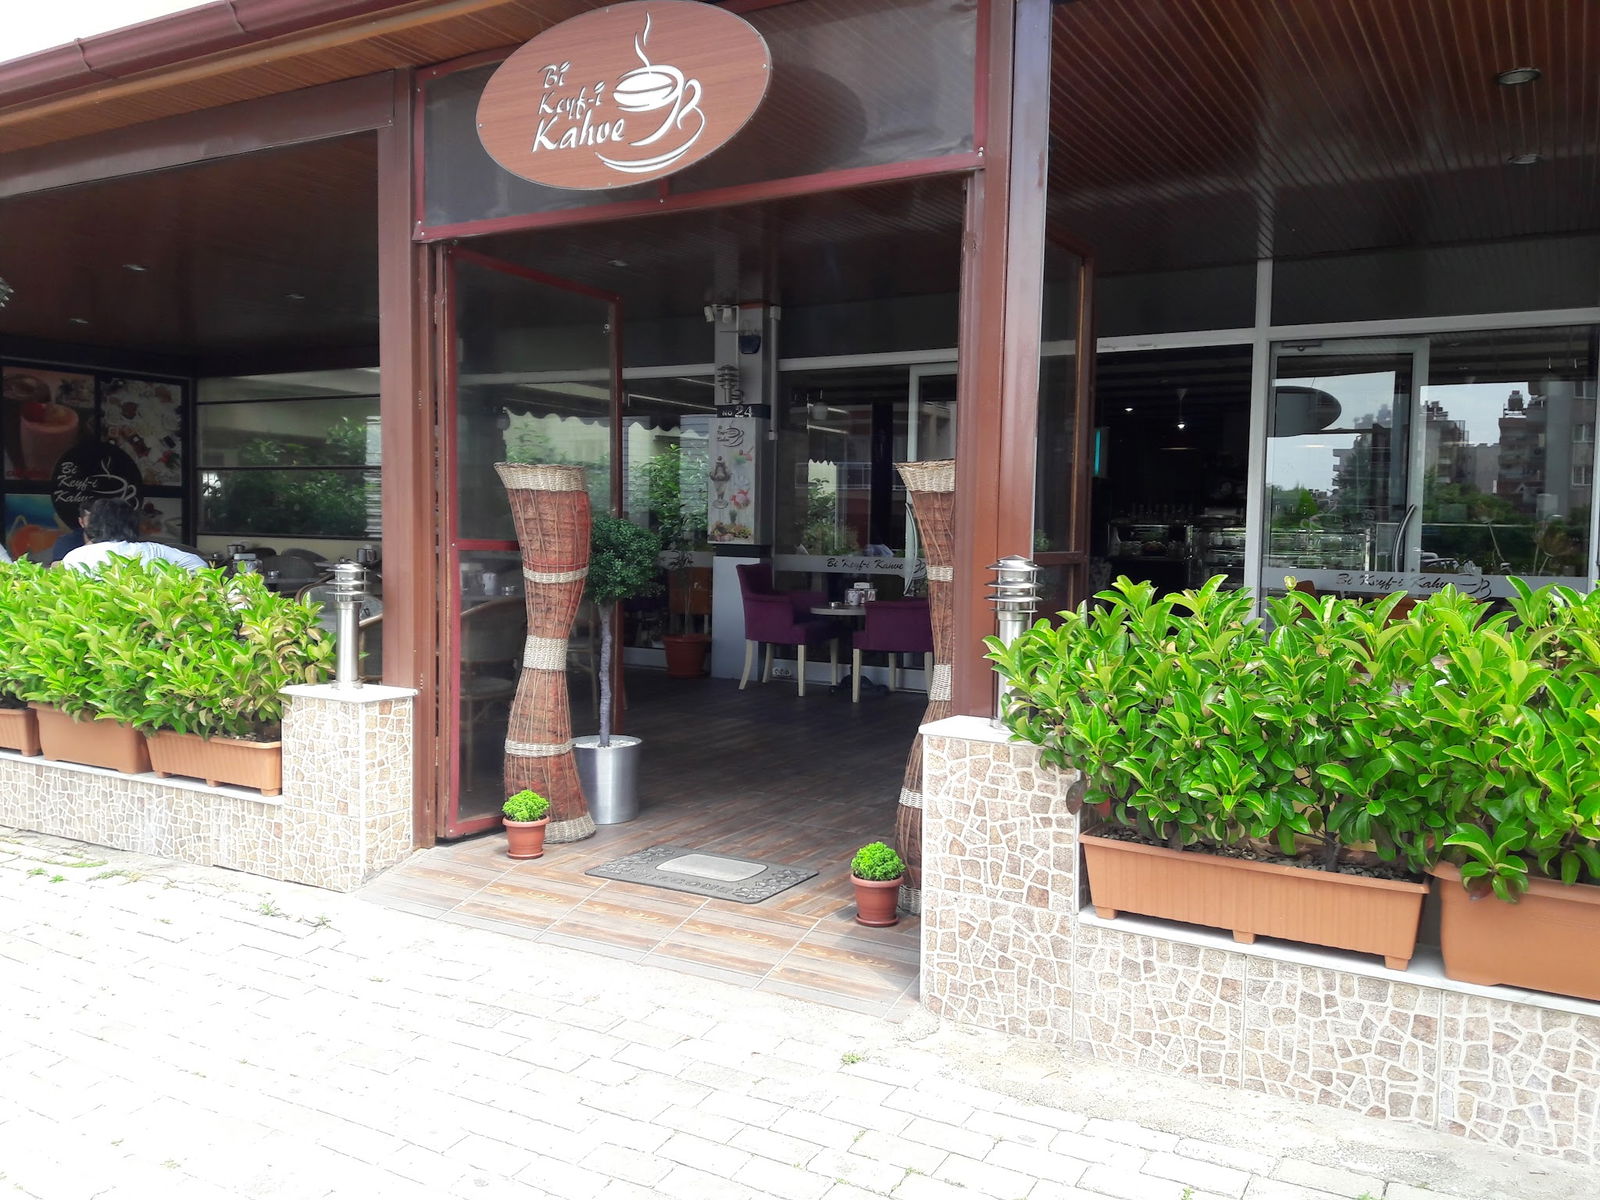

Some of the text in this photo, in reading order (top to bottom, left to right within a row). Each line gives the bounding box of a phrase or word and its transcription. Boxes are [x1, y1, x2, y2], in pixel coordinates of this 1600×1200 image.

[532, 109, 624, 152] Kahve
[61, 461, 78, 474] Bi
[1410, 576, 1455, 589] Kahv
